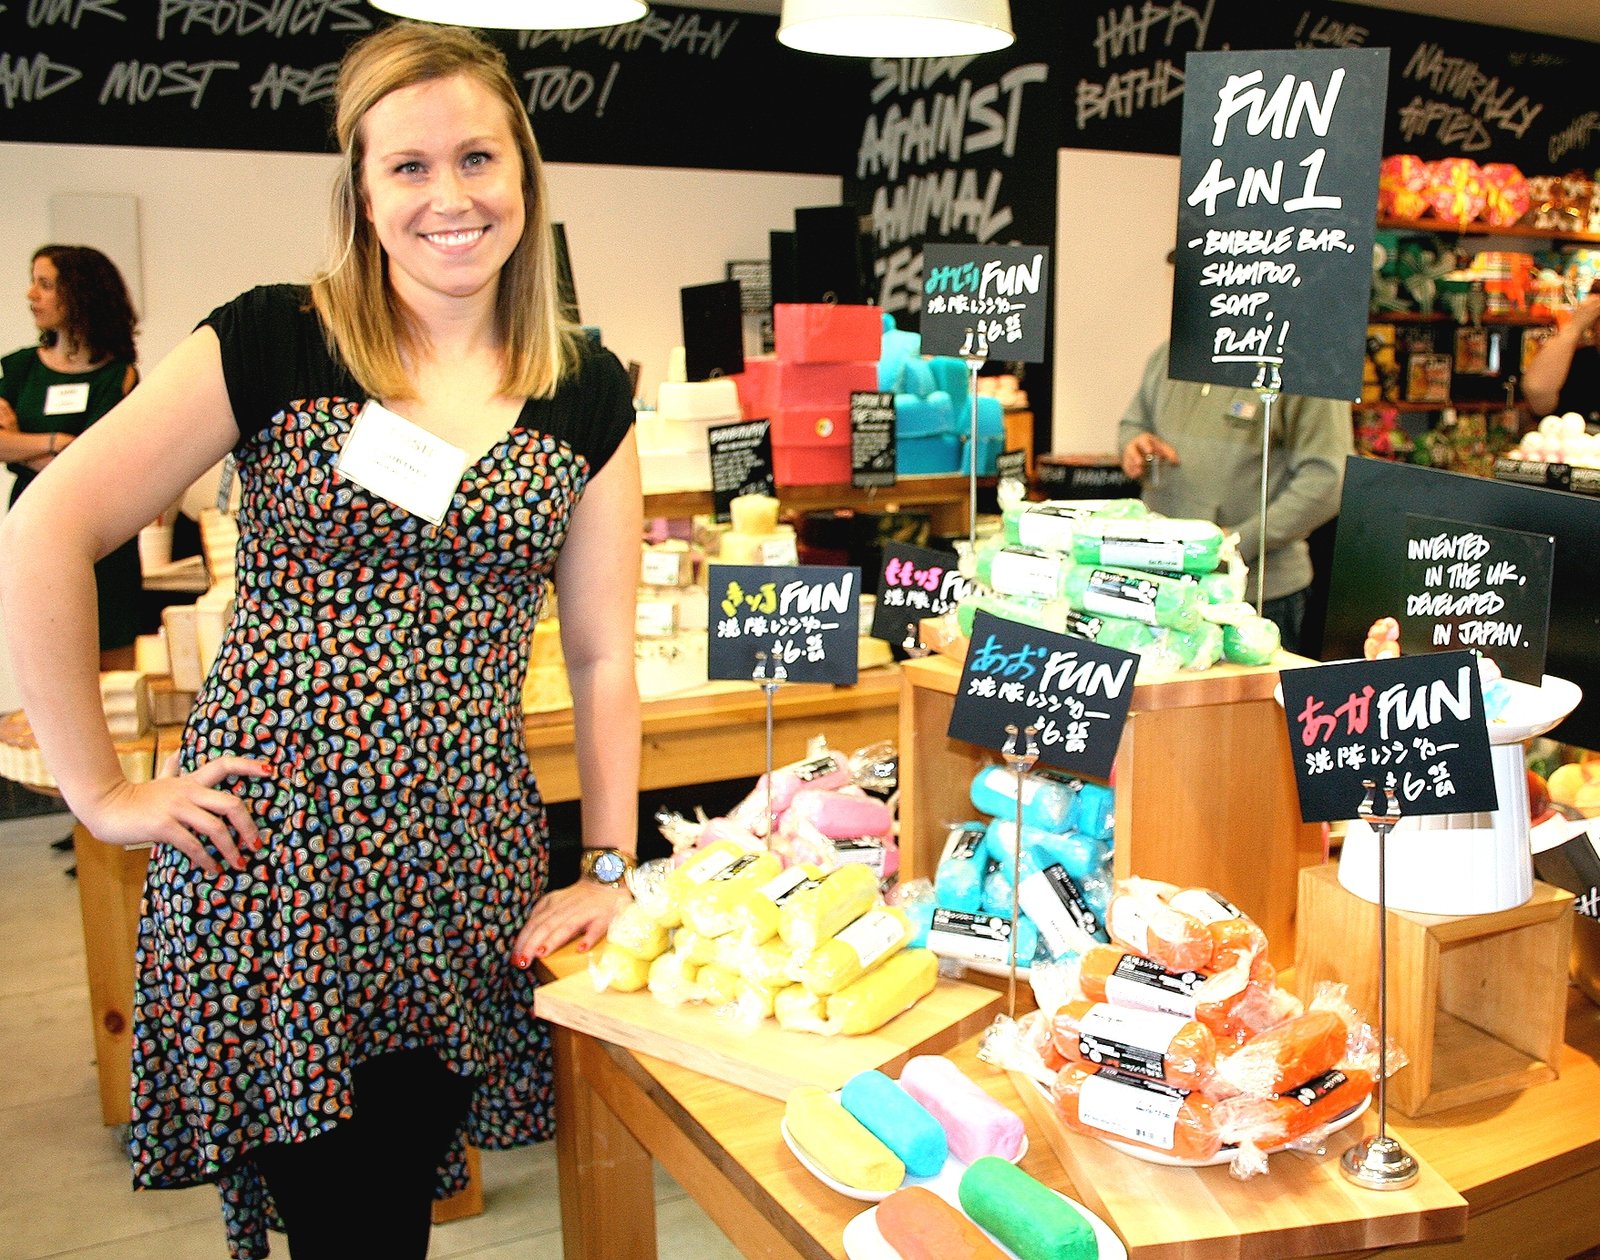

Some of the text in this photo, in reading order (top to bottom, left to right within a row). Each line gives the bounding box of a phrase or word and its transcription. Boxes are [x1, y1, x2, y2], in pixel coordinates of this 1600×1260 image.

[155, 0, 373, 40] PRODUCTS
[1093, 0, 1216, 68] HAPPY
[98, 59, 241, 110] MOST
[522, 61, 621, 118] TOO!
[1211, 67, 1346, 147] FUN
[857, 63, 1049, 182] AGAINST
[1187, 148, 1343, 216] 4 IN 1
[871, 168, 1013, 249] ANIMAL
[979, 254, 1043, 300] FUN
[1213, 319, 1291, 356] PLAY!
[1407, 532, 1491, 561] INVENTED
[780, 572, 854, 616] FUN
[1424, 564, 1444, 588] IN
[1447, 562, 1481, 590] THE
[1406, 590, 1505, 617] DEVELOPED
[1432, 623, 1453, 646] IN
[1039, 651, 1133, 700] FUN
[1376, 666, 1471, 740] FUN
